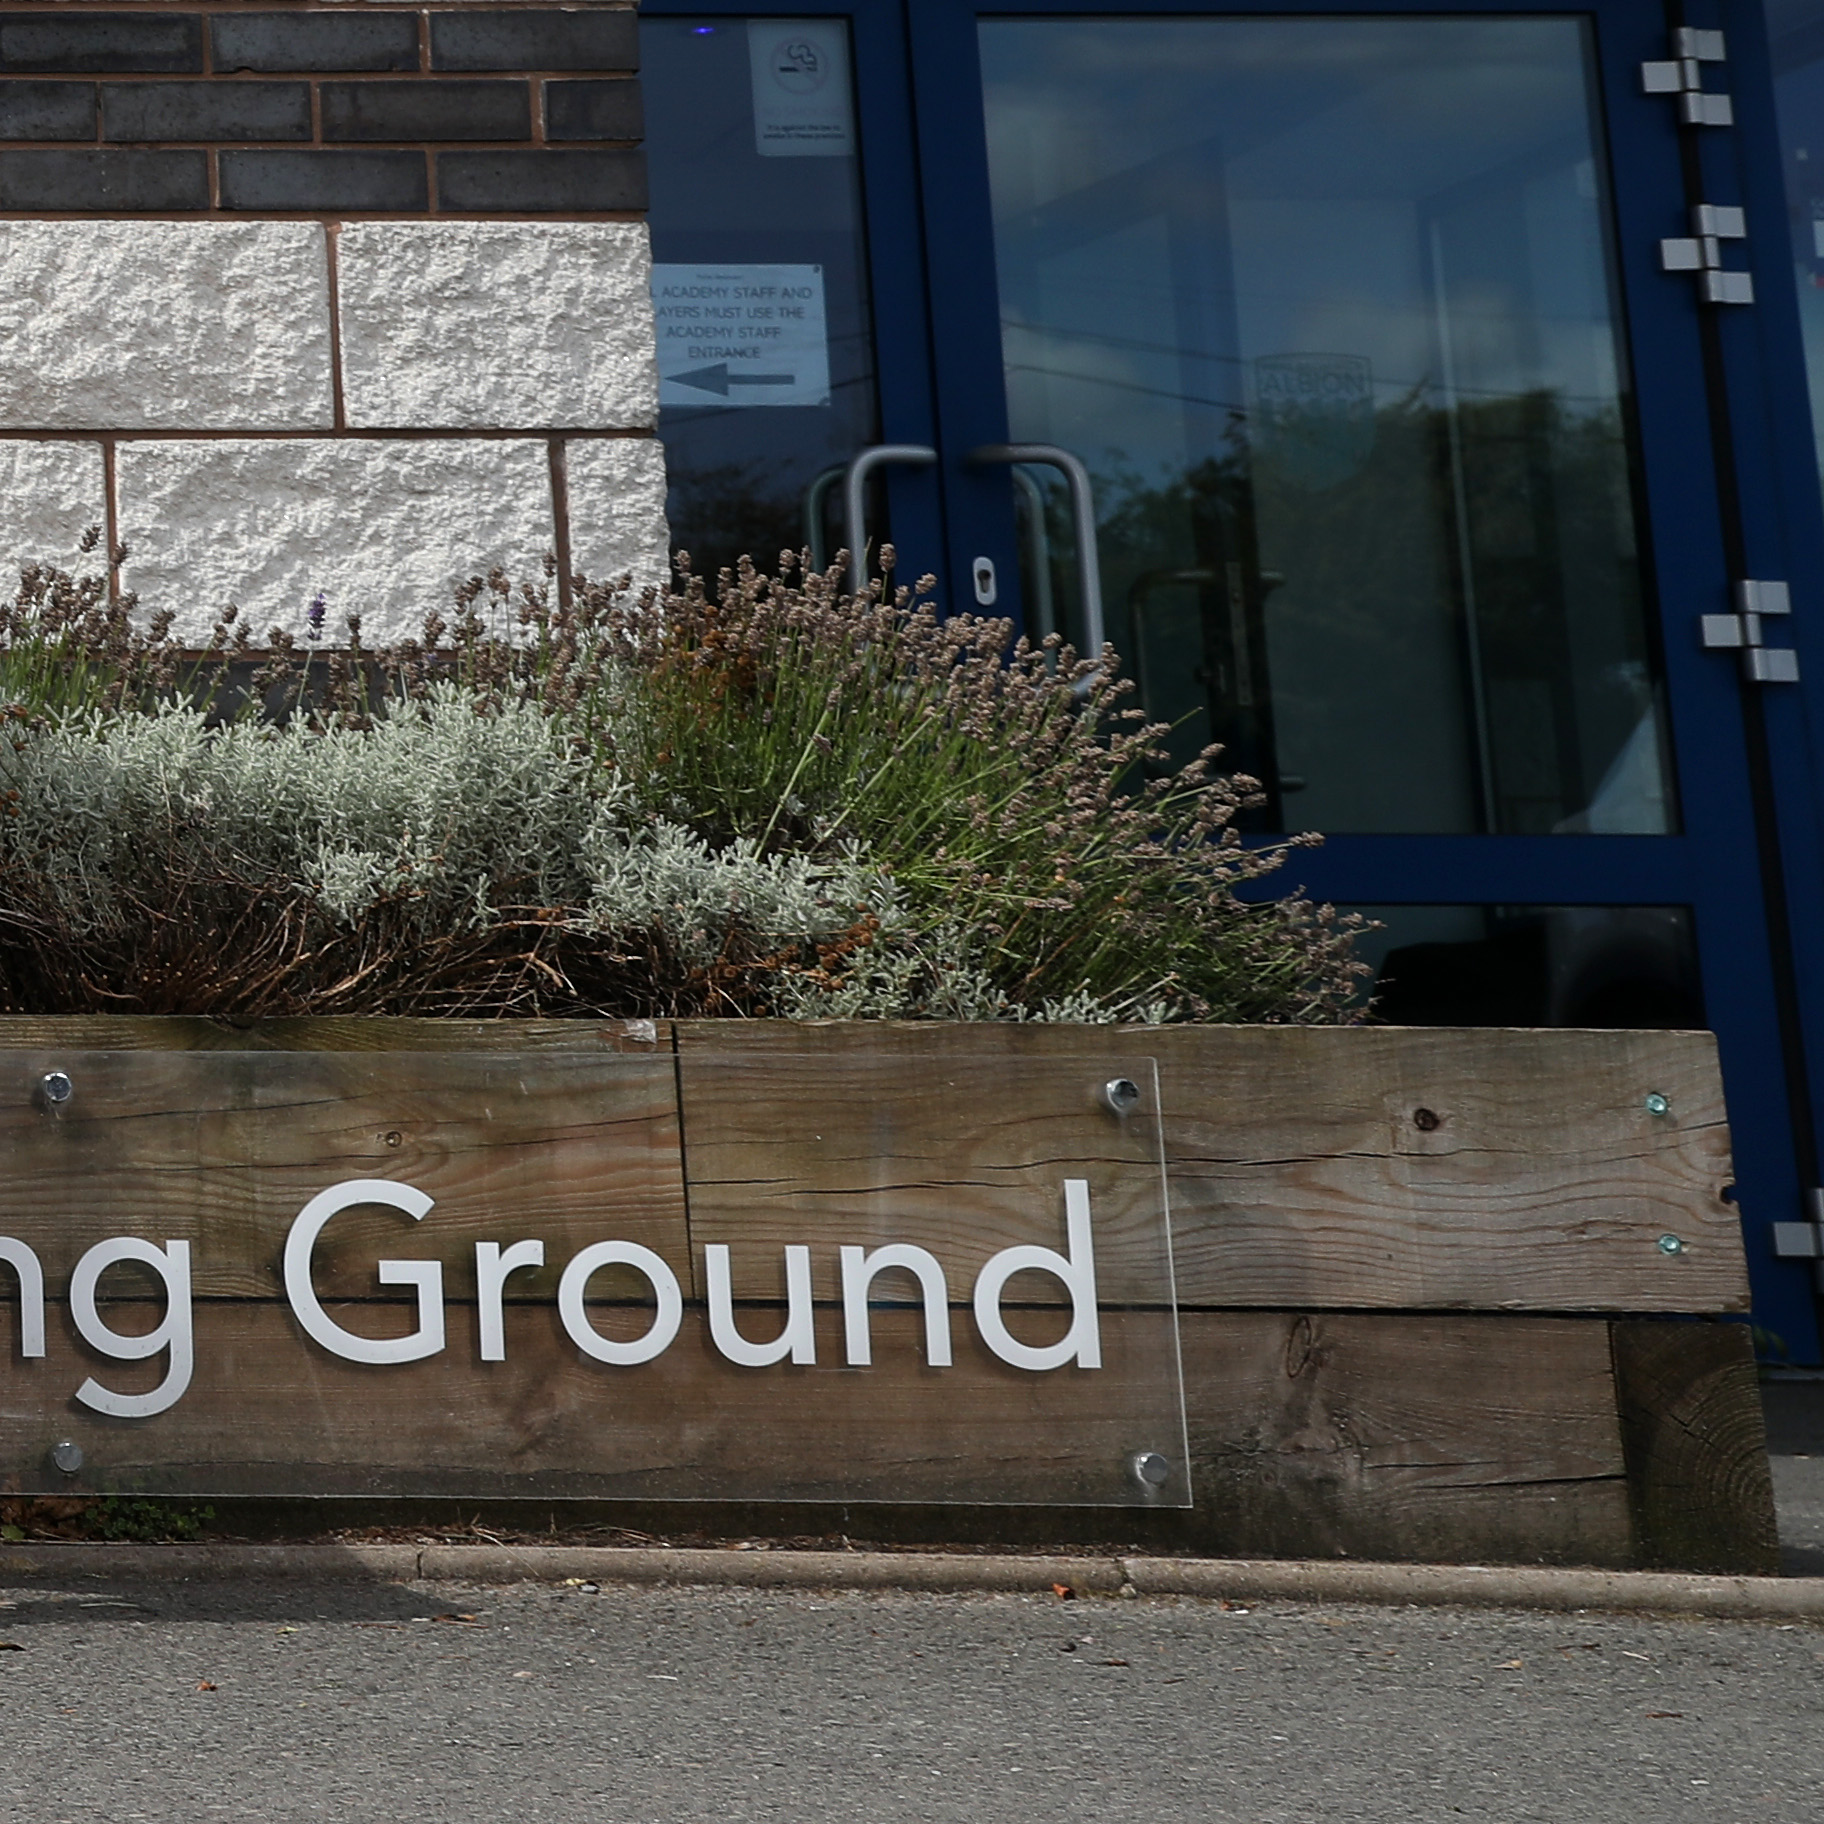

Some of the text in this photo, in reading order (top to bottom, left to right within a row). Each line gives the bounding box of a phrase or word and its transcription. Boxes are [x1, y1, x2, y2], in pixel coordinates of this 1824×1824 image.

[661, 286, 730, 299] ACADEMY
[733, 286, 777, 299] STAFF
[781, 287, 813, 300] AND
[654, 306, 805, 319] AYERS MUST USE THE
[665, 326, 782, 339] ACADEMY STAFF
[688, 346, 761, 359] ENTRANCE
[282, 1178, 1103, 1371] Ground
